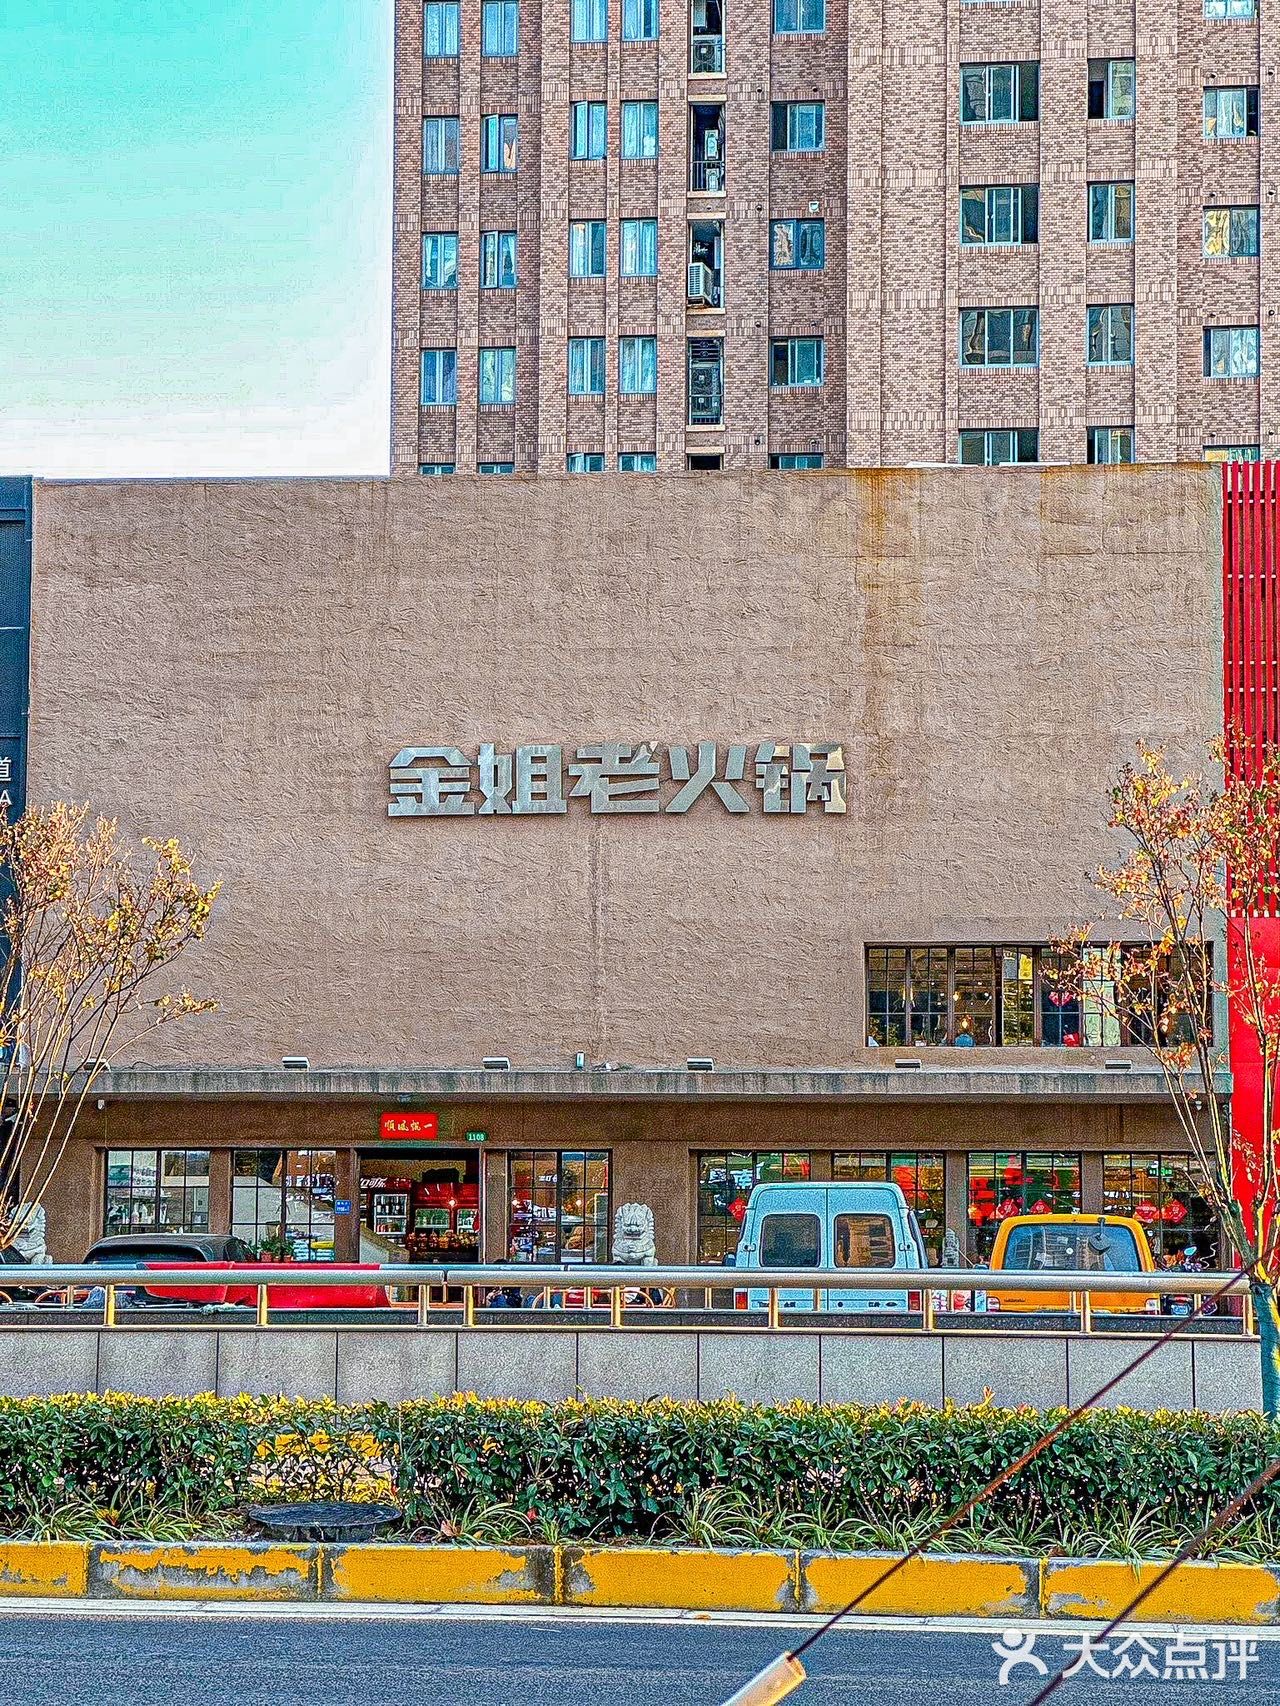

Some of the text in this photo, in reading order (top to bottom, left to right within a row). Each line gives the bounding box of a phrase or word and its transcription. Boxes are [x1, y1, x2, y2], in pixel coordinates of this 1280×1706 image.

[387, 741, 847, 816] 金姐老火锅
